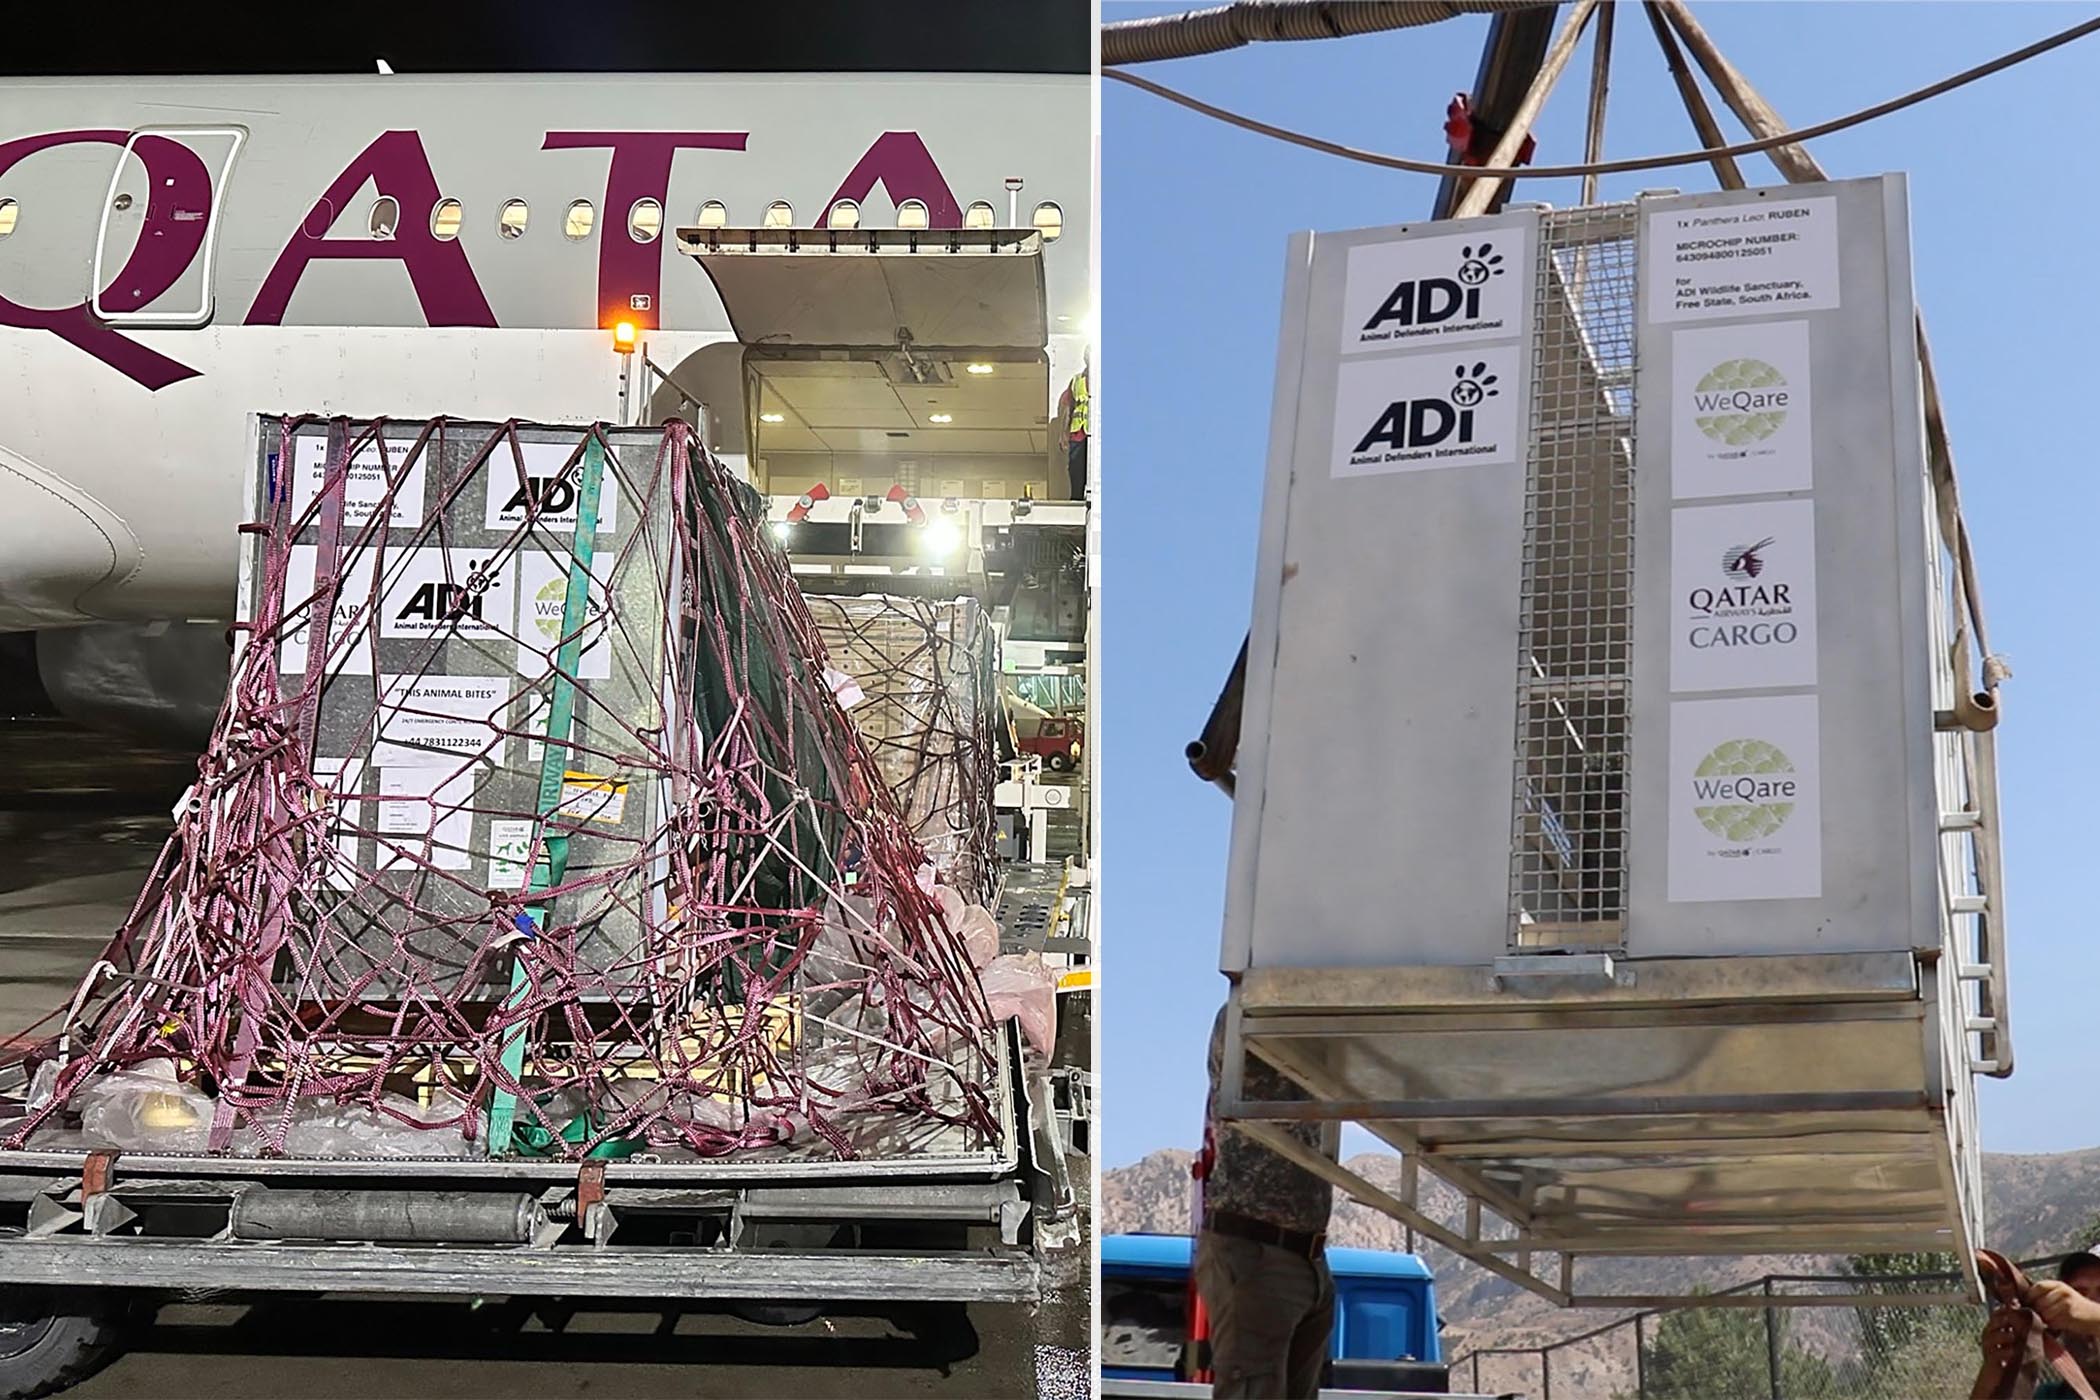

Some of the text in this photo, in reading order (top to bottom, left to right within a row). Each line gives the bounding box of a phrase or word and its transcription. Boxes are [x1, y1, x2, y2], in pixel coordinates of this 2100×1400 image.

[1677, 220, 1689, 229] 1x
[1692, 214, 1740, 227] Panthera
[1768, 208, 1811, 220] RUBEN
[1676, 237, 1743, 251] MICROCHIP
[1675, 278, 1691, 287] for
[1676, 288, 1697, 298] ADI
[1700, 284, 1741, 296] Wildlife
[1676, 290, 1812, 310] Free State, South Africa.
[1360, 319, 1503, 342] Animal Defenders International
[1694, 391, 1789, 412] WeQare
[385, 446, 409, 454] UBEN
[1350, 444, 1497, 466] Animal Defenders International
[499, 514, 523, 523] Animal
[1689, 583, 1792, 613] QATAR
[394, 621, 418, 630] Animal
[1689, 622, 1798, 649] CARGO
[423, 688, 463, 698] ANIMAL
[423, 738, 482, 747] 7831122344
[1693, 777, 1796, 803] WeQare
